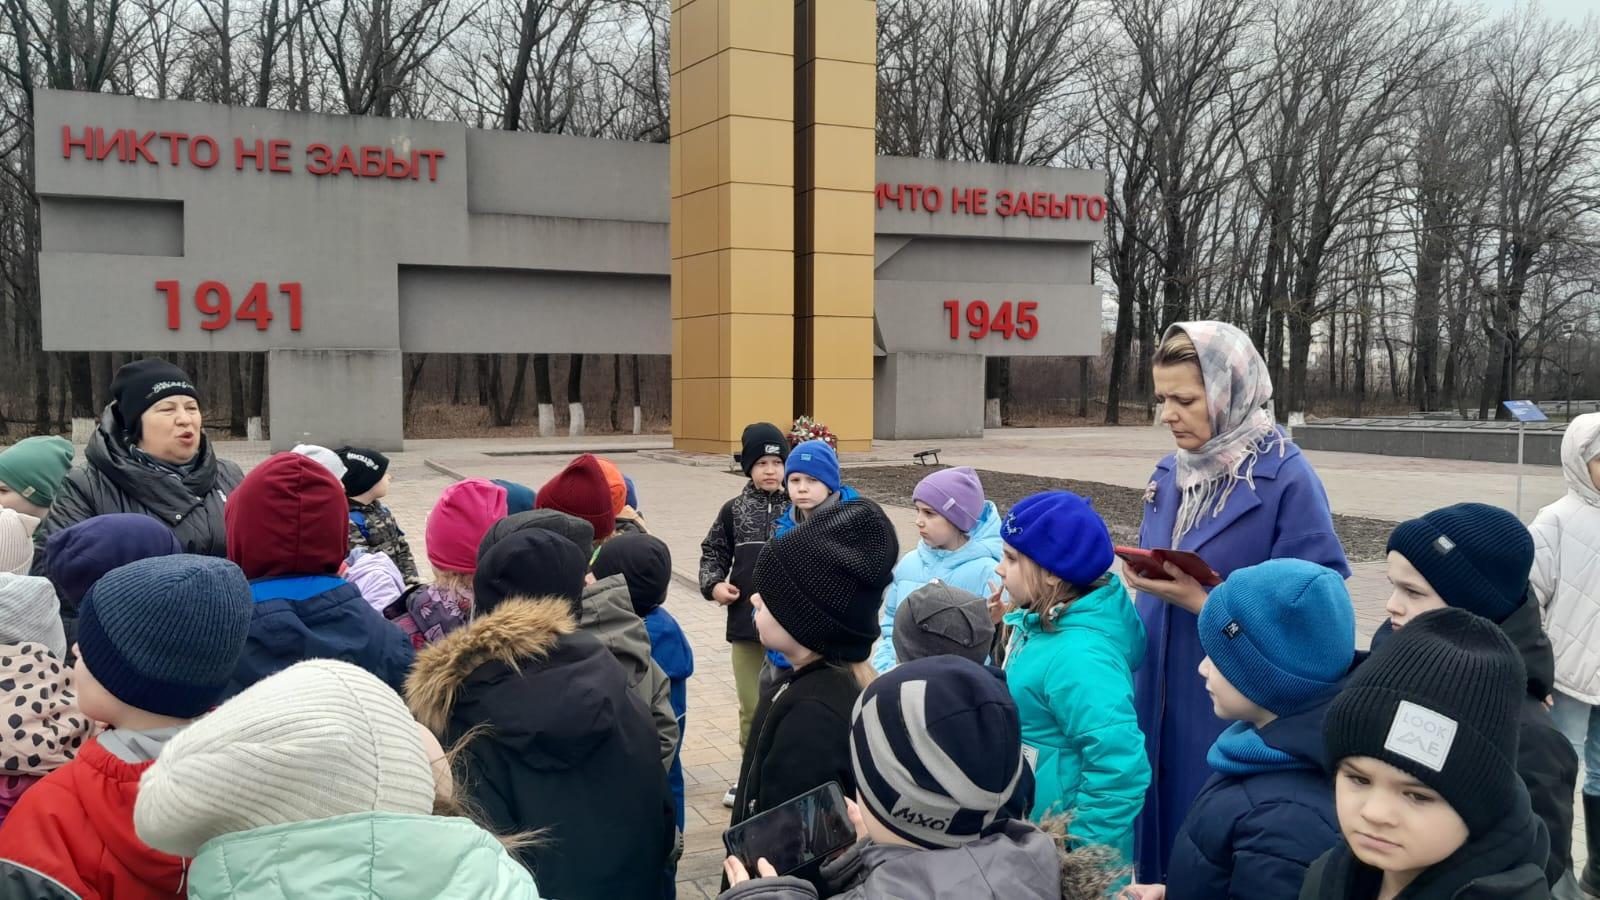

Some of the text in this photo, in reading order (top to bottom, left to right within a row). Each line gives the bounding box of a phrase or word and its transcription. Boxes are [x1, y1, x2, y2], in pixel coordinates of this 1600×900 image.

[62, 125, 445, 181] НИКТО НЕ ЗАБЫТ
[952, 187, 989, 215] НЕ
[996, 189, 1106, 222] ЗАБЫТО
[155, 279, 303, 331] 1941
[943, 299, 1040, 340] 1945
[1403, 711, 1447, 740] LOOK
